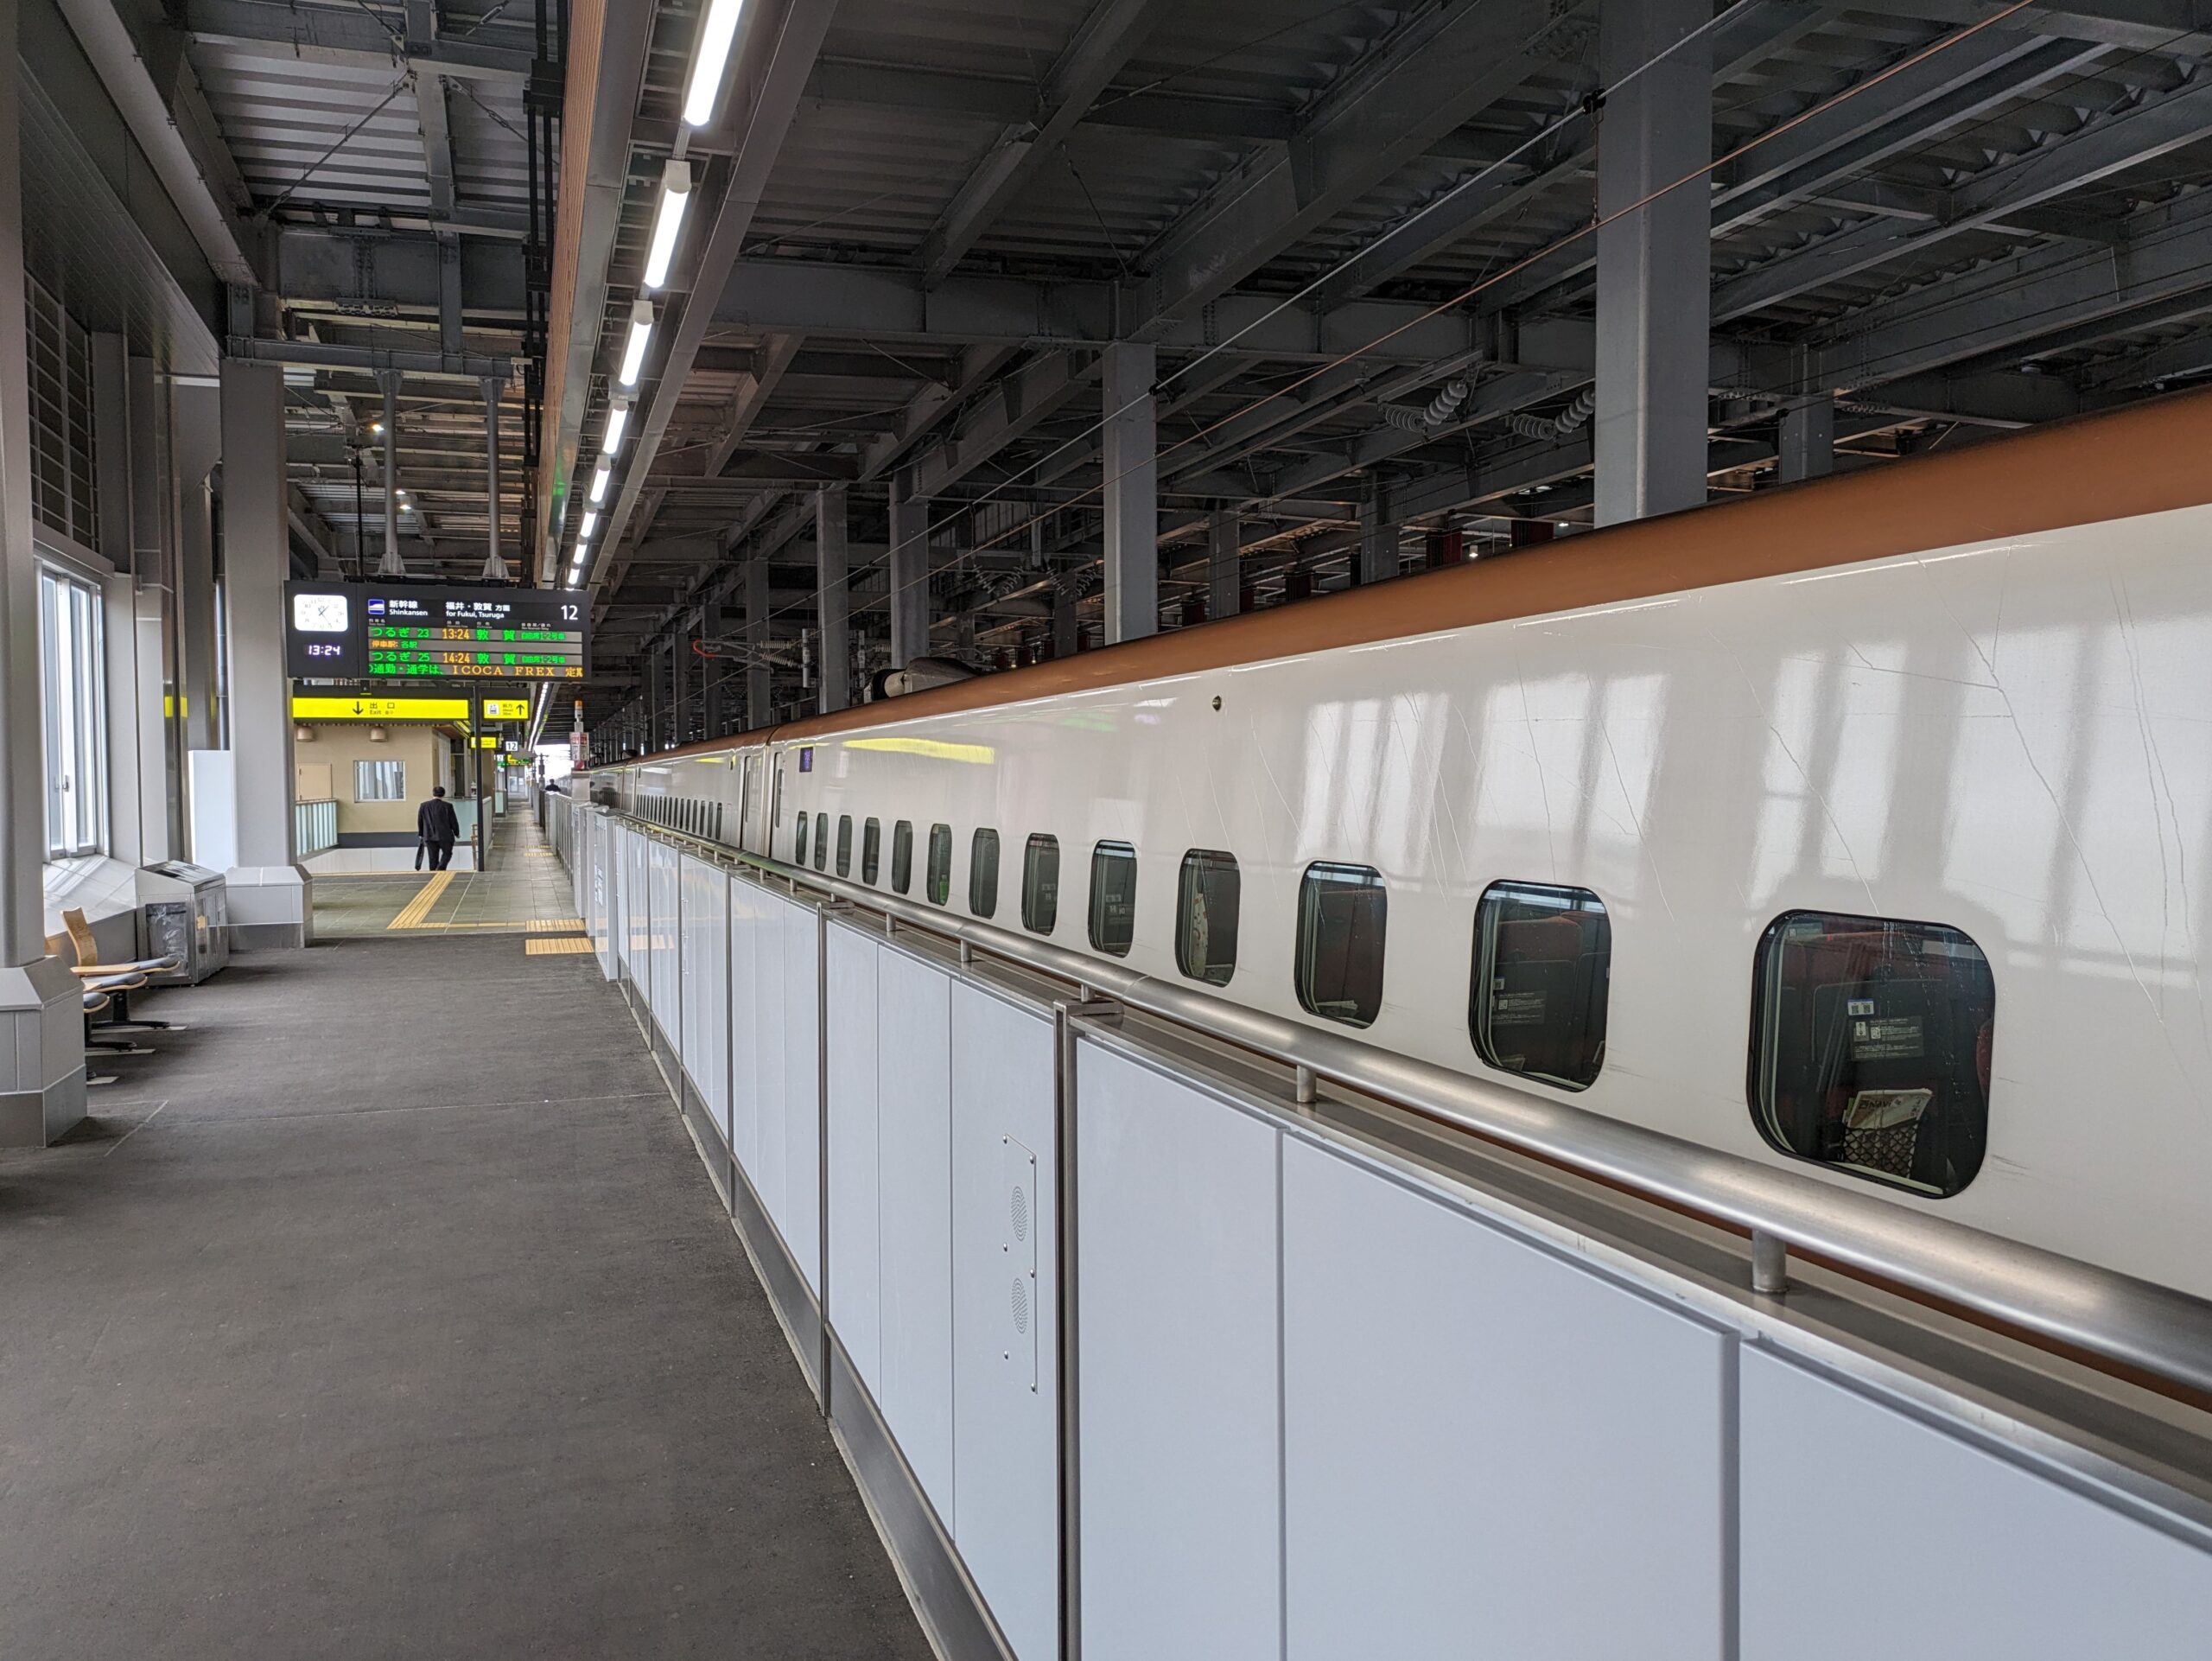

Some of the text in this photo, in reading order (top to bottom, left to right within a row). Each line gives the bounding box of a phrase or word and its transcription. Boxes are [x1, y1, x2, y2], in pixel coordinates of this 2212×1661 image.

[389, 600, 418, 608] 新幹線
[446, 601, 493, 611] 福井・敦賀
[561, 605, 578, 620] 12
[372, 627, 410, 638] つるぎ
[417, 629, 429, 638] 23
[442, 628, 470, 640] 13:24
[308, 645, 340, 656] 13:24
[372, 652, 410, 662] つるぎ
[418, 652, 430, 662] 25
[442, 652, 471, 664] 14:24
[453, 665, 503, 676] ICOCA
[515, 666, 555, 677] FREX
